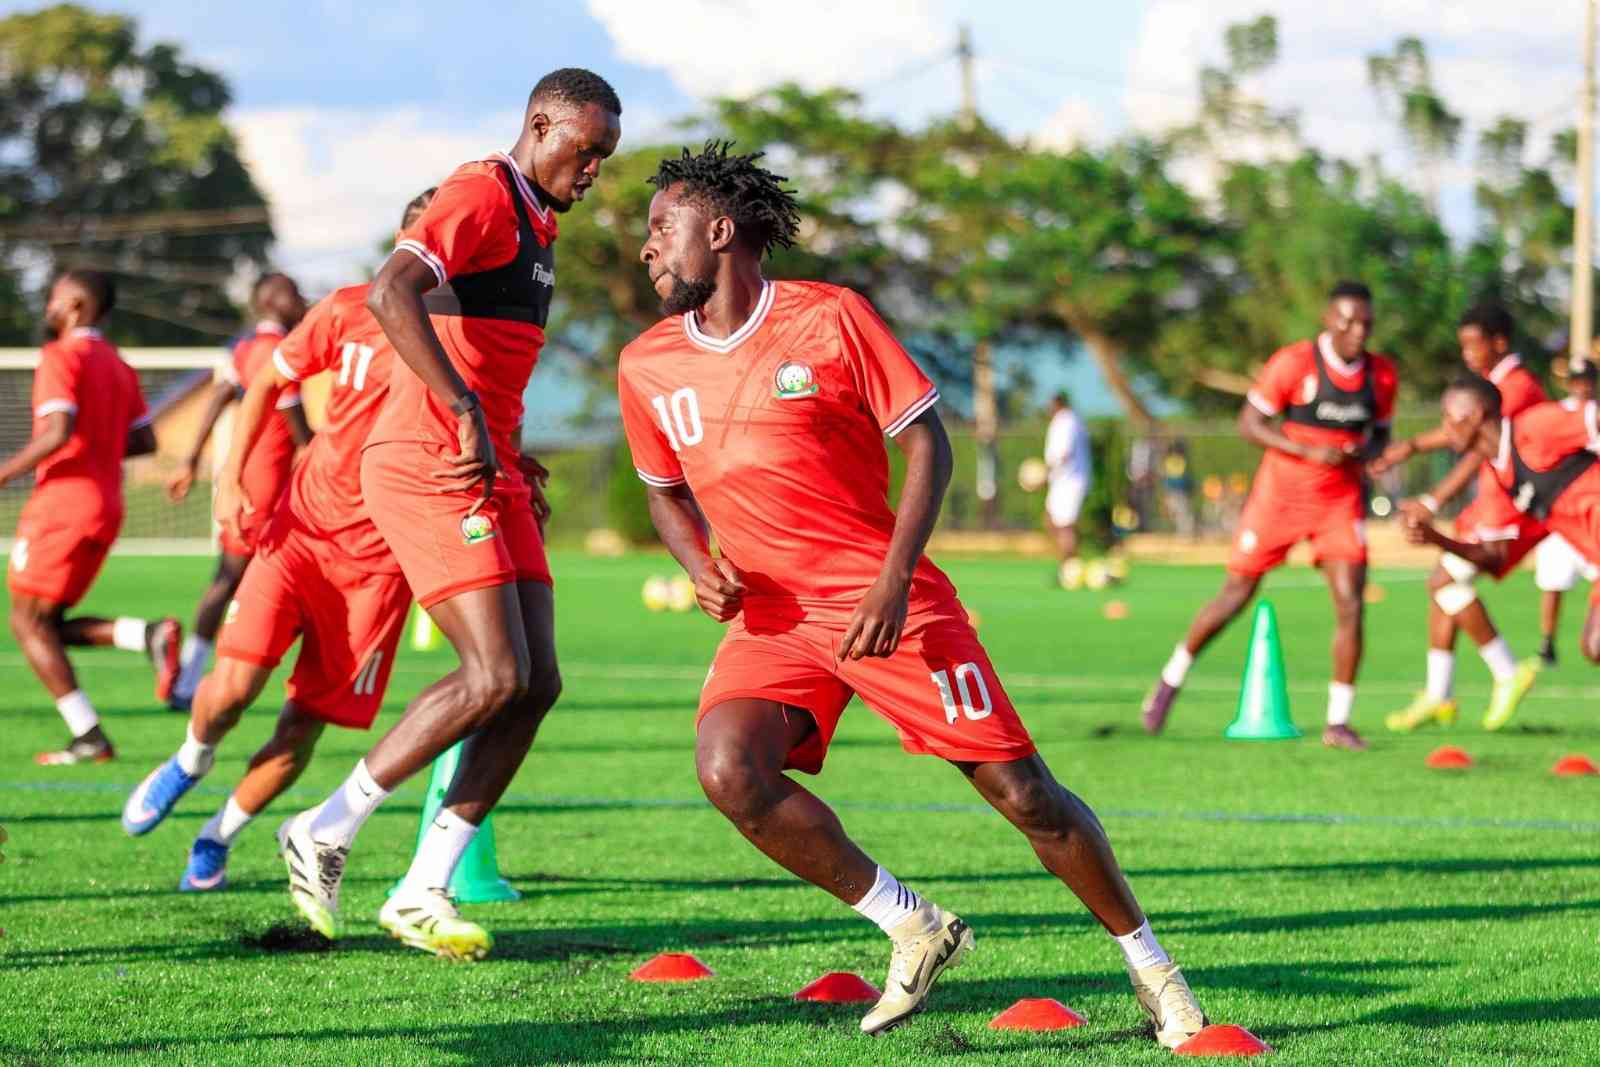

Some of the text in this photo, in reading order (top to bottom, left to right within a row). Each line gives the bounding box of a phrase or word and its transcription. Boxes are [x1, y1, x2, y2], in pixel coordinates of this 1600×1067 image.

[338, 342, 375, 391] 11
[651, 387, 704, 452] 10
[354, 650, 384, 695] 11
[930, 662, 993, 725] 10
